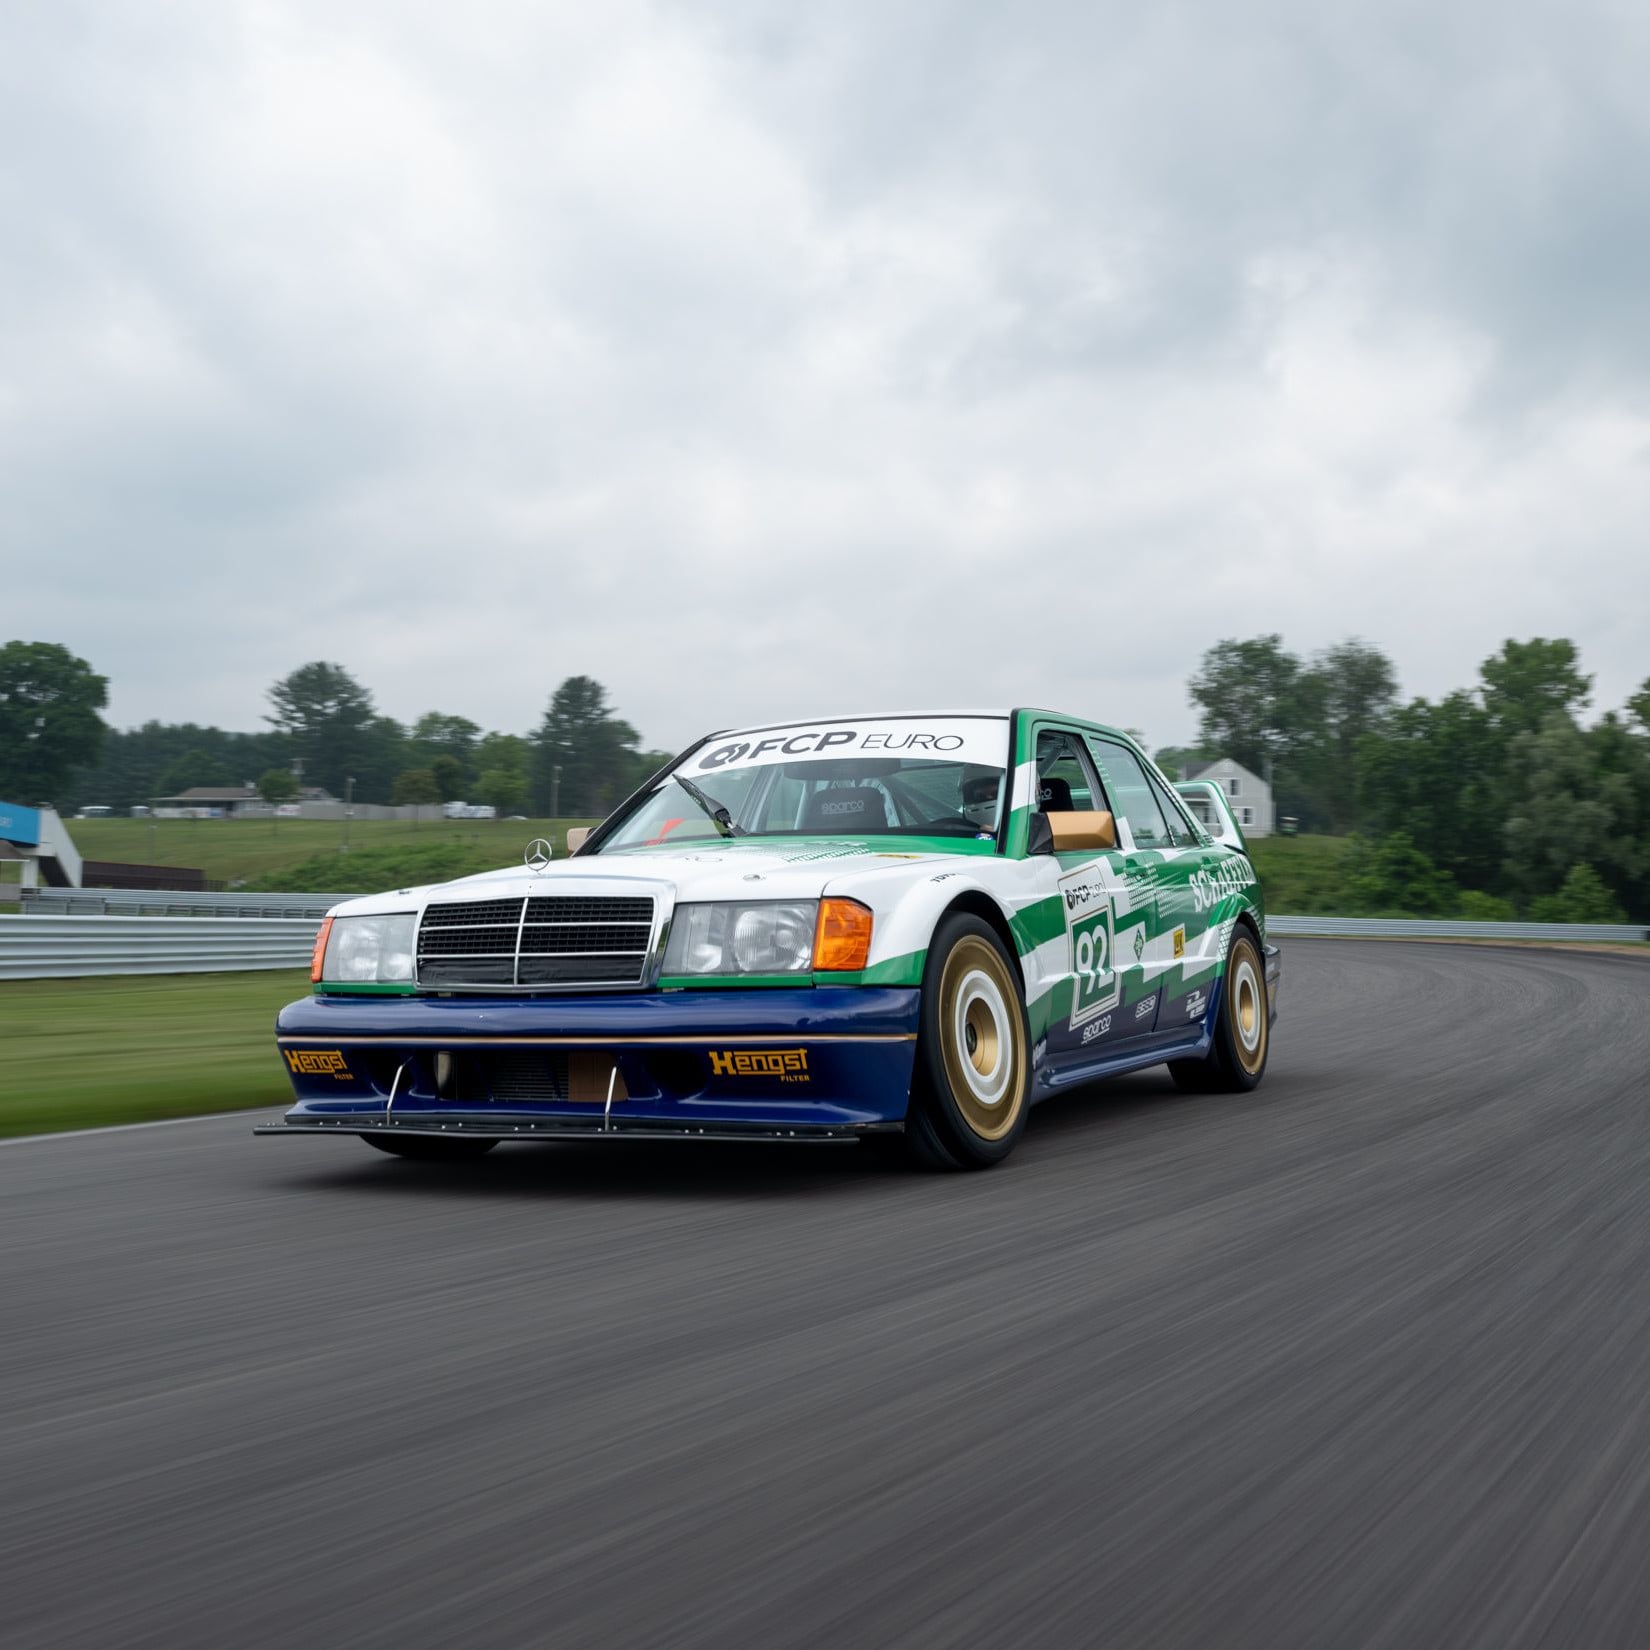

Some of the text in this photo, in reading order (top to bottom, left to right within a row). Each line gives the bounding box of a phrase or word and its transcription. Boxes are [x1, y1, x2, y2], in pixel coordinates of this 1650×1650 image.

[747, 731, 964, 759] FCP EURO
[1072, 884, 1090, 905] FCP
[1076, 925, 1114, 995] 92
[284, 1050, 348, 1073] Hengst
[708, 1048, 808, 1075] Hengst
